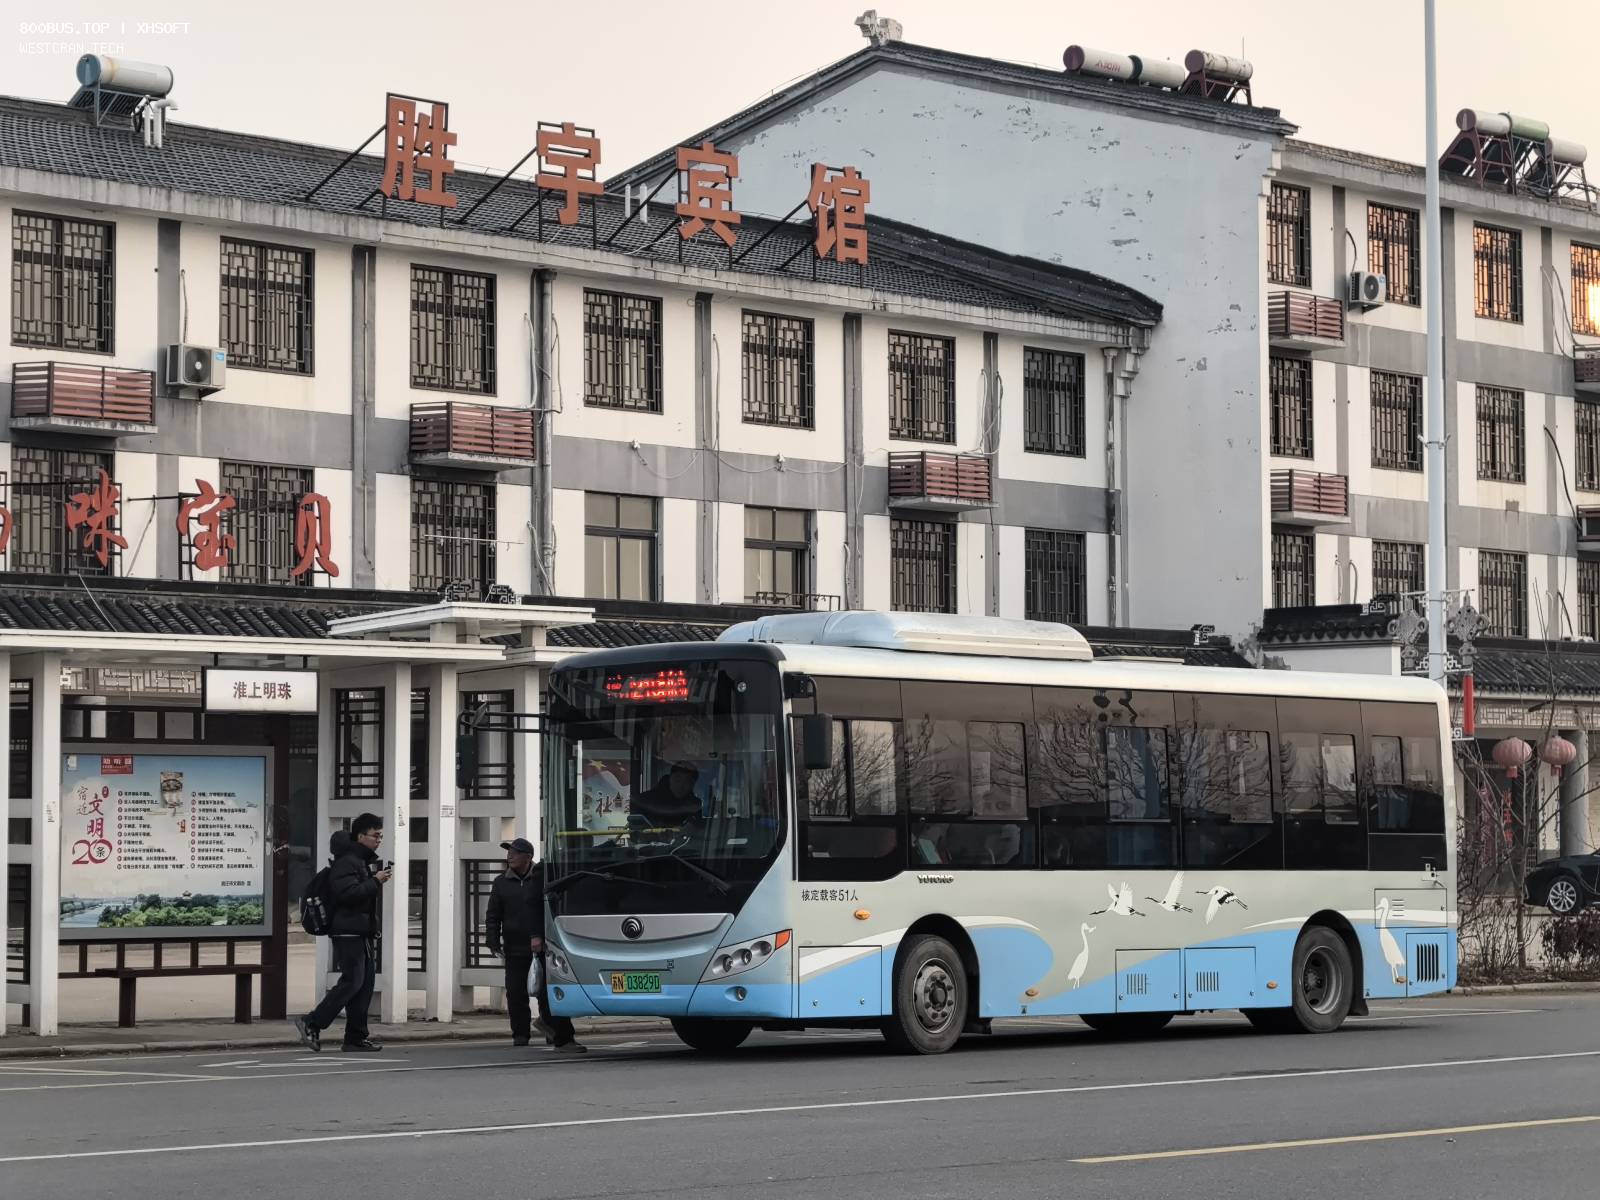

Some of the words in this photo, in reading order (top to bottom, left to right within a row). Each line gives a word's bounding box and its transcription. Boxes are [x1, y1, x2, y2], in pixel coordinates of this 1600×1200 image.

[381, 96, 870, 265] 胜宇宾馆
[233, 681, 292, 700] 淮上明珠
[917, 874, 954, 884] YUTONG
[801, 889, 858, 902] 核定载客51人
